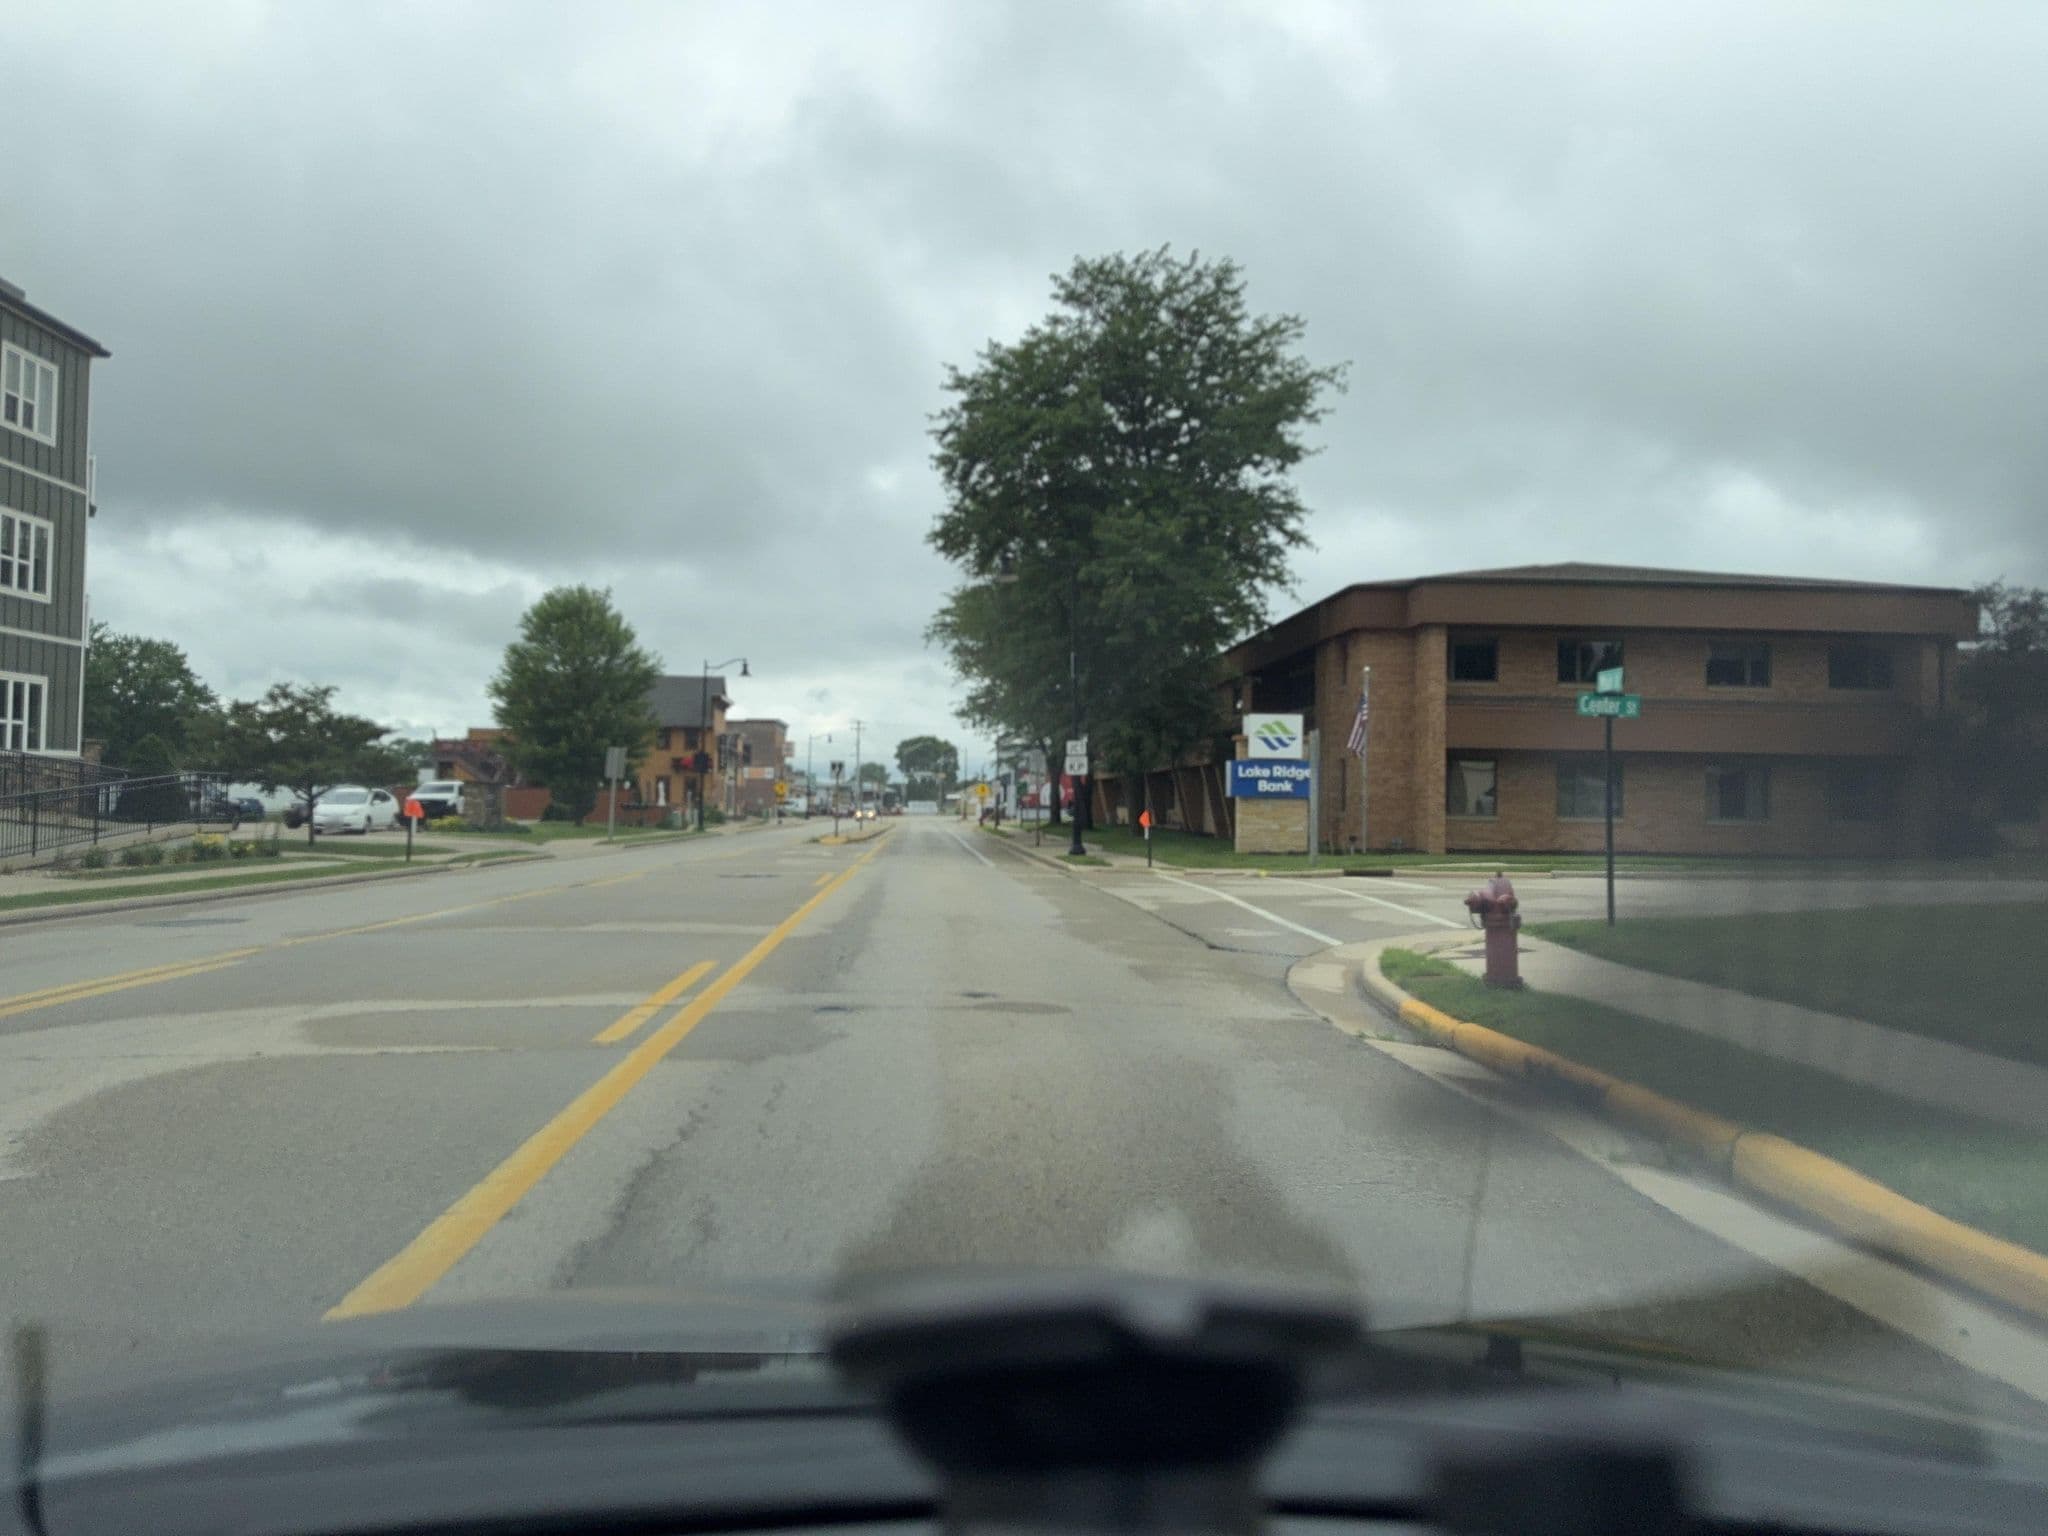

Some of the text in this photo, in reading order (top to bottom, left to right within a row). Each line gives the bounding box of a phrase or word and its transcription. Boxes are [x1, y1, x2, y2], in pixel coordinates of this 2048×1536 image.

[1580, 695, 1620, 713] Center
[1238, 765, 1312, 780] Lake Ridge
[1257, 780, 1293, 792] Bank
